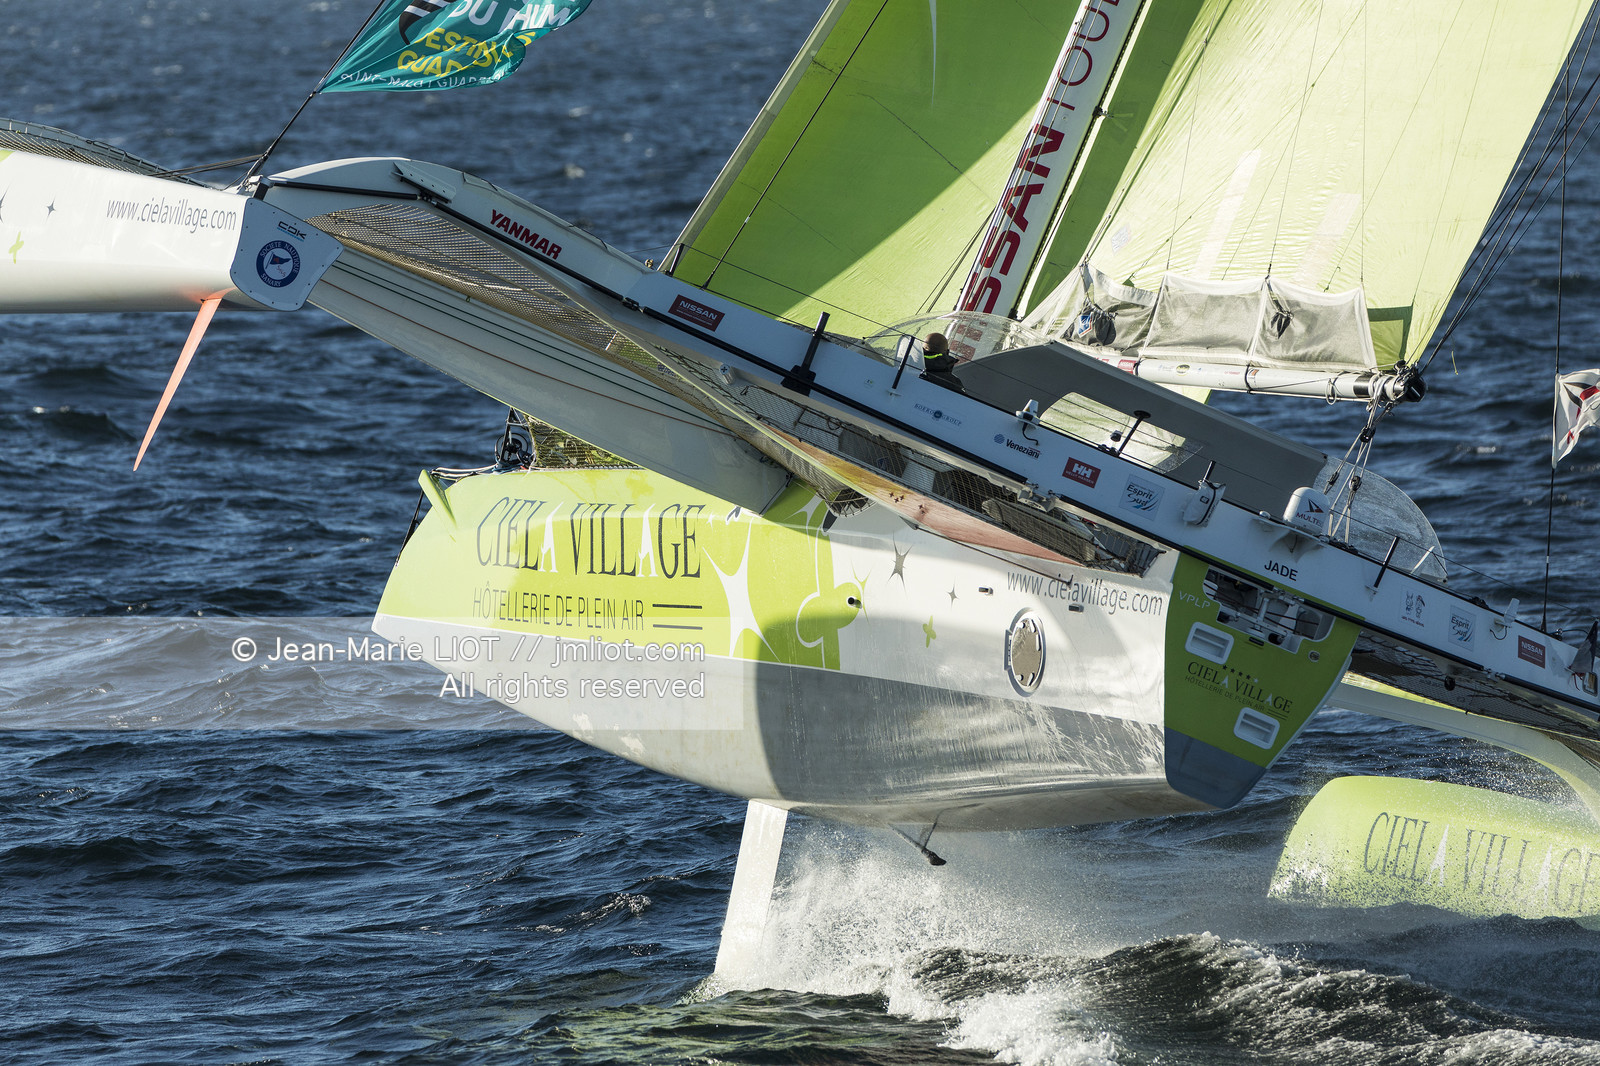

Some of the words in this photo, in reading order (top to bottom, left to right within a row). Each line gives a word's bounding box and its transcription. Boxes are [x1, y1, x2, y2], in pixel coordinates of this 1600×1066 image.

[106, 198, 237, 234] www.cielavillage.com
[278, 221, 307, 240] CDK
[489, 209, 563, 260] YANMAR
[679, 300, 718, 320] NISSAN
[1005, 439, 1040, 459] Veneziani
[1072, 463, 1093, 479] HH
[1127, 484, 1154, 500] Esprit
[476, 496, 564, 573] CIELA
[569, 502, 707, 580] VILLAGE
[1264, 560, 1298, 582] JADE
[1007, 571, 1163, 616] www.cielavillage.com
[1179, 591, 1211, 609] VPLP
[473, 581, 551, 626] HÔTELLERIE
[555, 594, 573, 628] DE
[578, 596, 616, 630] PLEIN
[621, 599, 644, 631] AIR
[1521, 640, 1543, 656] NISSAN
[1187, 661, 1229, 689] CIELA
[1235, 679, 1293, 714] VILLAGE
[1363, 812, 1450, 888] CIELA
